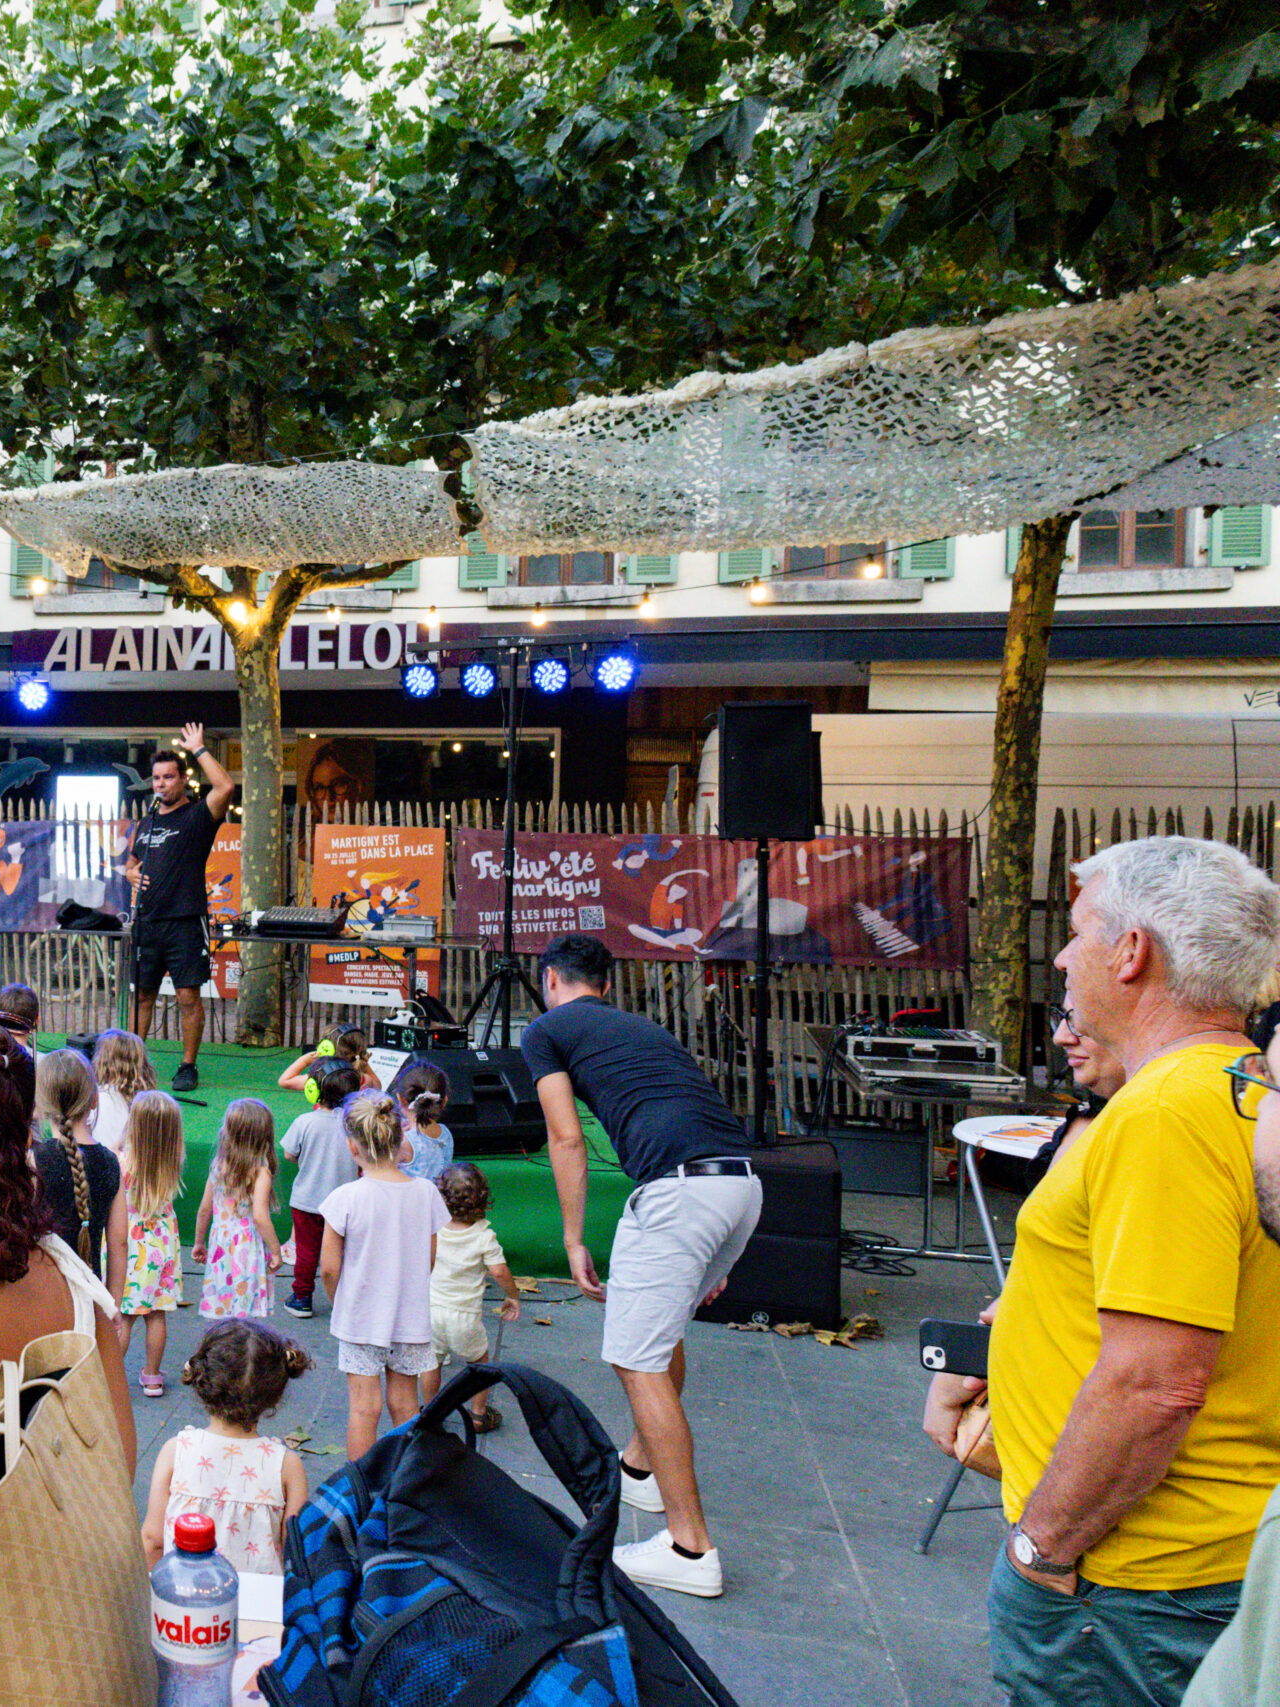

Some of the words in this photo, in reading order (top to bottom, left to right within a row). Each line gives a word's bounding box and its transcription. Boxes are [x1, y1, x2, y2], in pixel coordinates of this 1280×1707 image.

[43, 625, 193, 672] ALAIN
[183, 619, 440, 671] ALELOU
[217, 840, 241, 852] PLAC
[331, 836, 380, 849] MARTIGNY
[382, 834, 400, 846] EST
[360, 847, 386, 859] DANS
[389, 847, 401, 858] LA
[404, 844, 434, 857] PLACE
[471, 848, 597, 880] Fetiv'été
[478, 909, 518, 922] TOUTS
[521, 909, 540, 921] LES
[543, 907, 575, 919] INFOS
[478, 924, 500, 935] SUR
[503, 920, 577, 934] ESTIVETE.CH
[328, 952, 359, 963] #MEDLP
